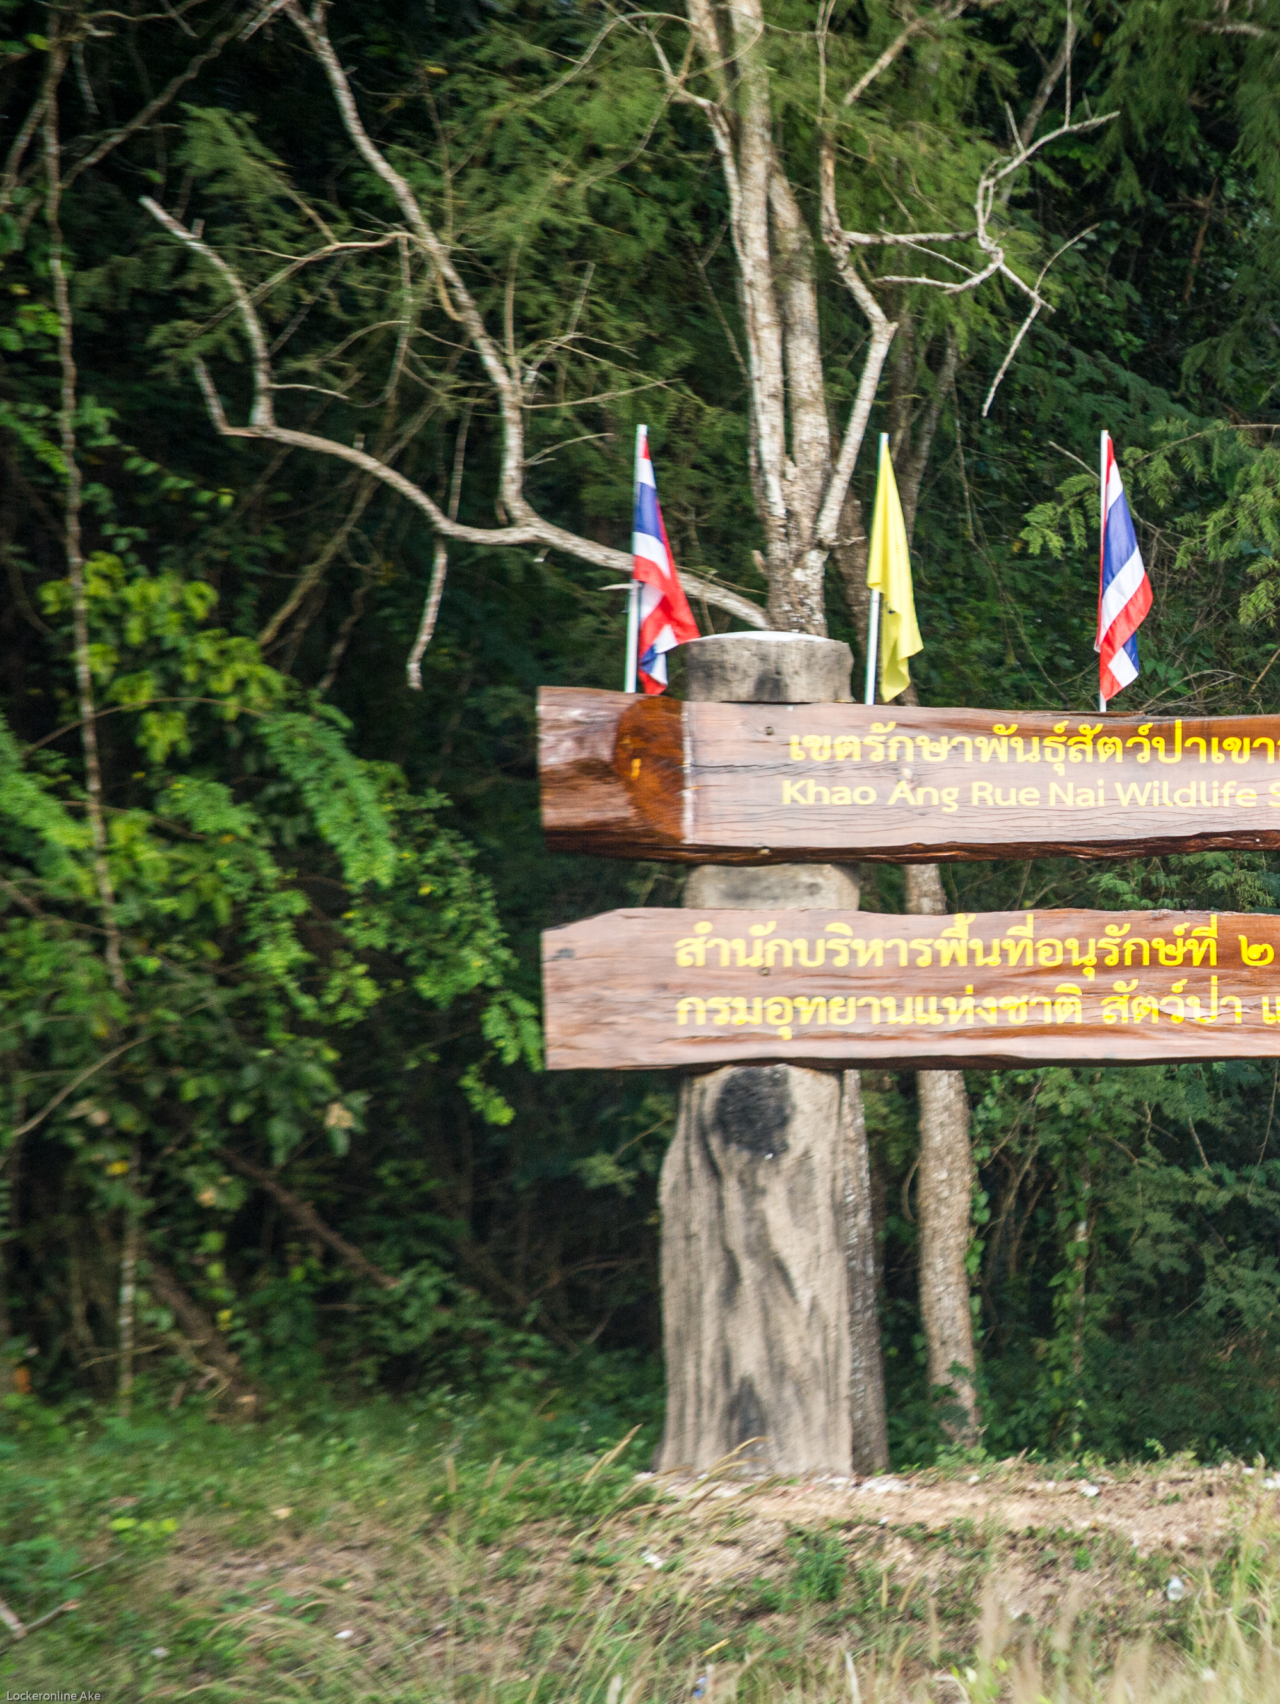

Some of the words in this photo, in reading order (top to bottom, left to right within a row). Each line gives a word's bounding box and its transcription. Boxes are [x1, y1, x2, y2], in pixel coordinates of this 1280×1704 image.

[781, 779, 877, 806] Khao
[887, 780, 959, 813] Ang
[972, 781, 1041, 807] Rue
[1049, 779, 1105, 807] Nai
[1115, 780, 1258, 808] Wildlife
[1238, 934, 1275, 967] ๒
[674, 982, 1083, 1041] กรมอุทยานแห่งชาติ
[1101, 974, 1243, 1025] สัตว์ป่า
